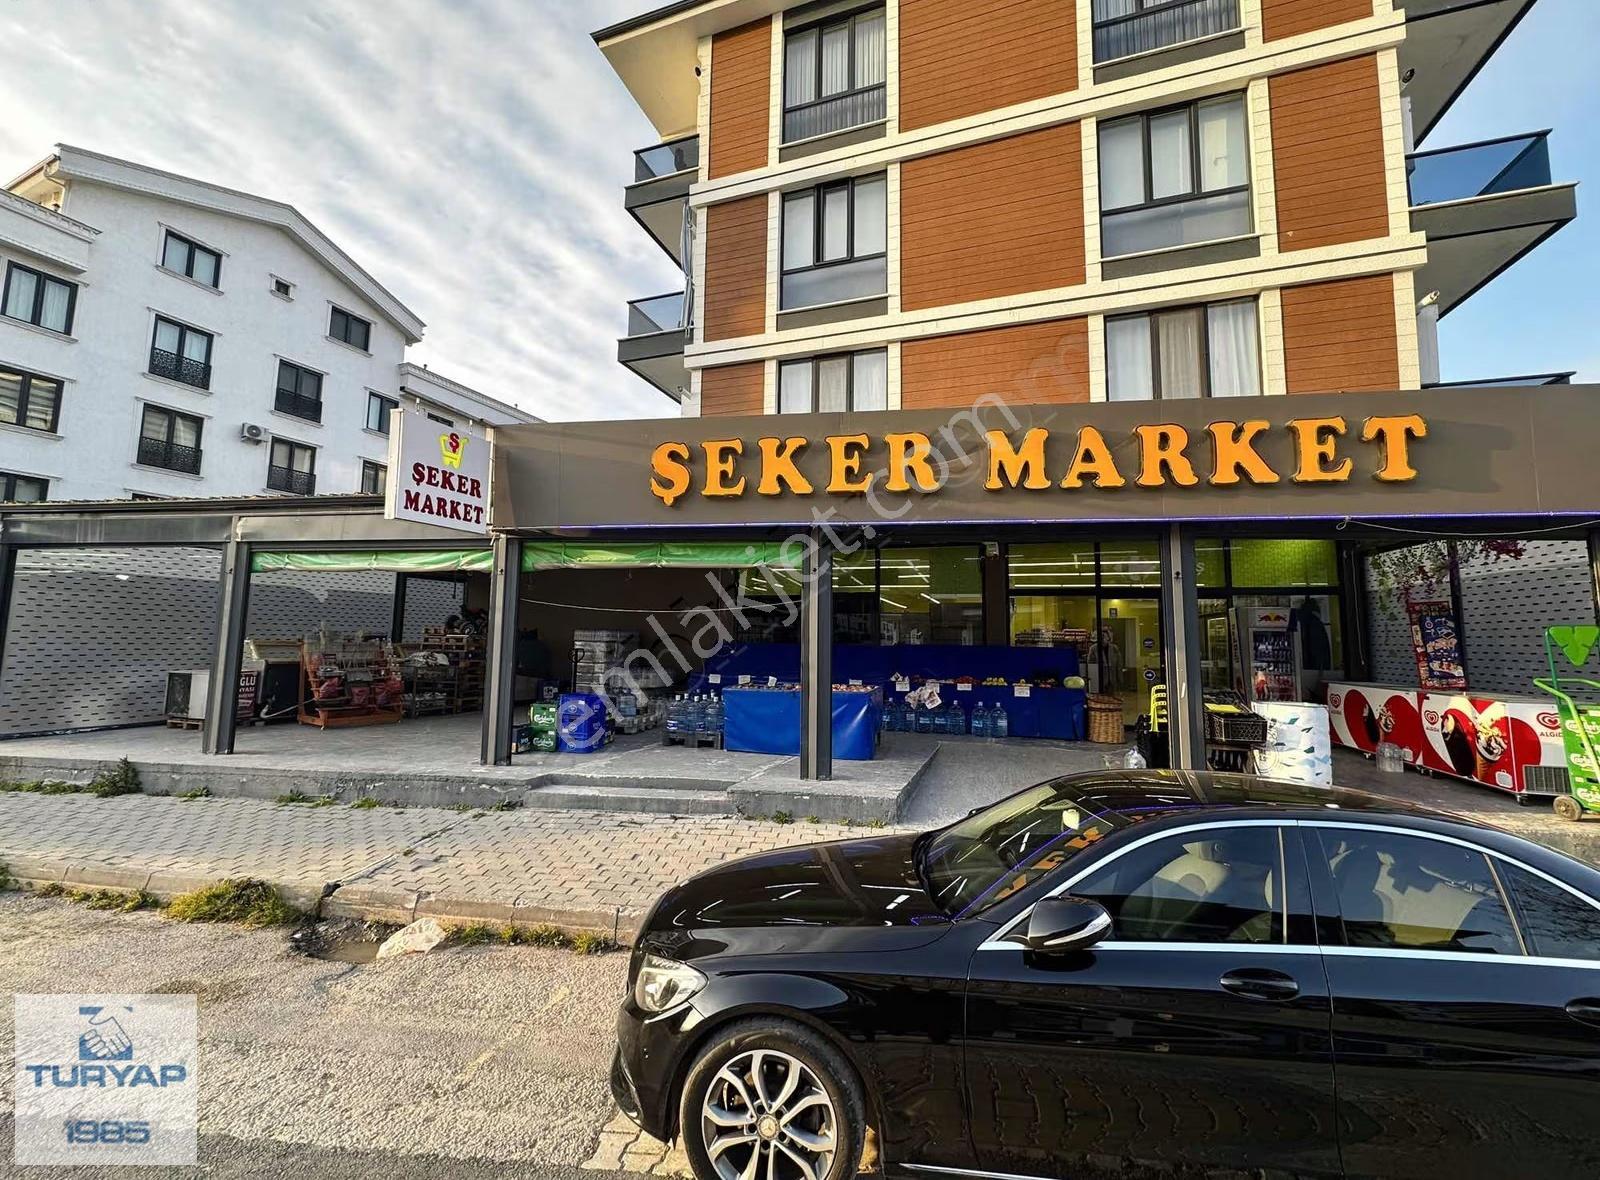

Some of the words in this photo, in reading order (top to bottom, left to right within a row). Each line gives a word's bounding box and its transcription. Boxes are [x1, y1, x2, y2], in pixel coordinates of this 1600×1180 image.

[651, 431, 941, 507] ŞEKER
[983, 414, 1427, 489] MARKET
[412, 462, 482, 499] ŞEKER
[404, 489, 484, 524] MARKET
